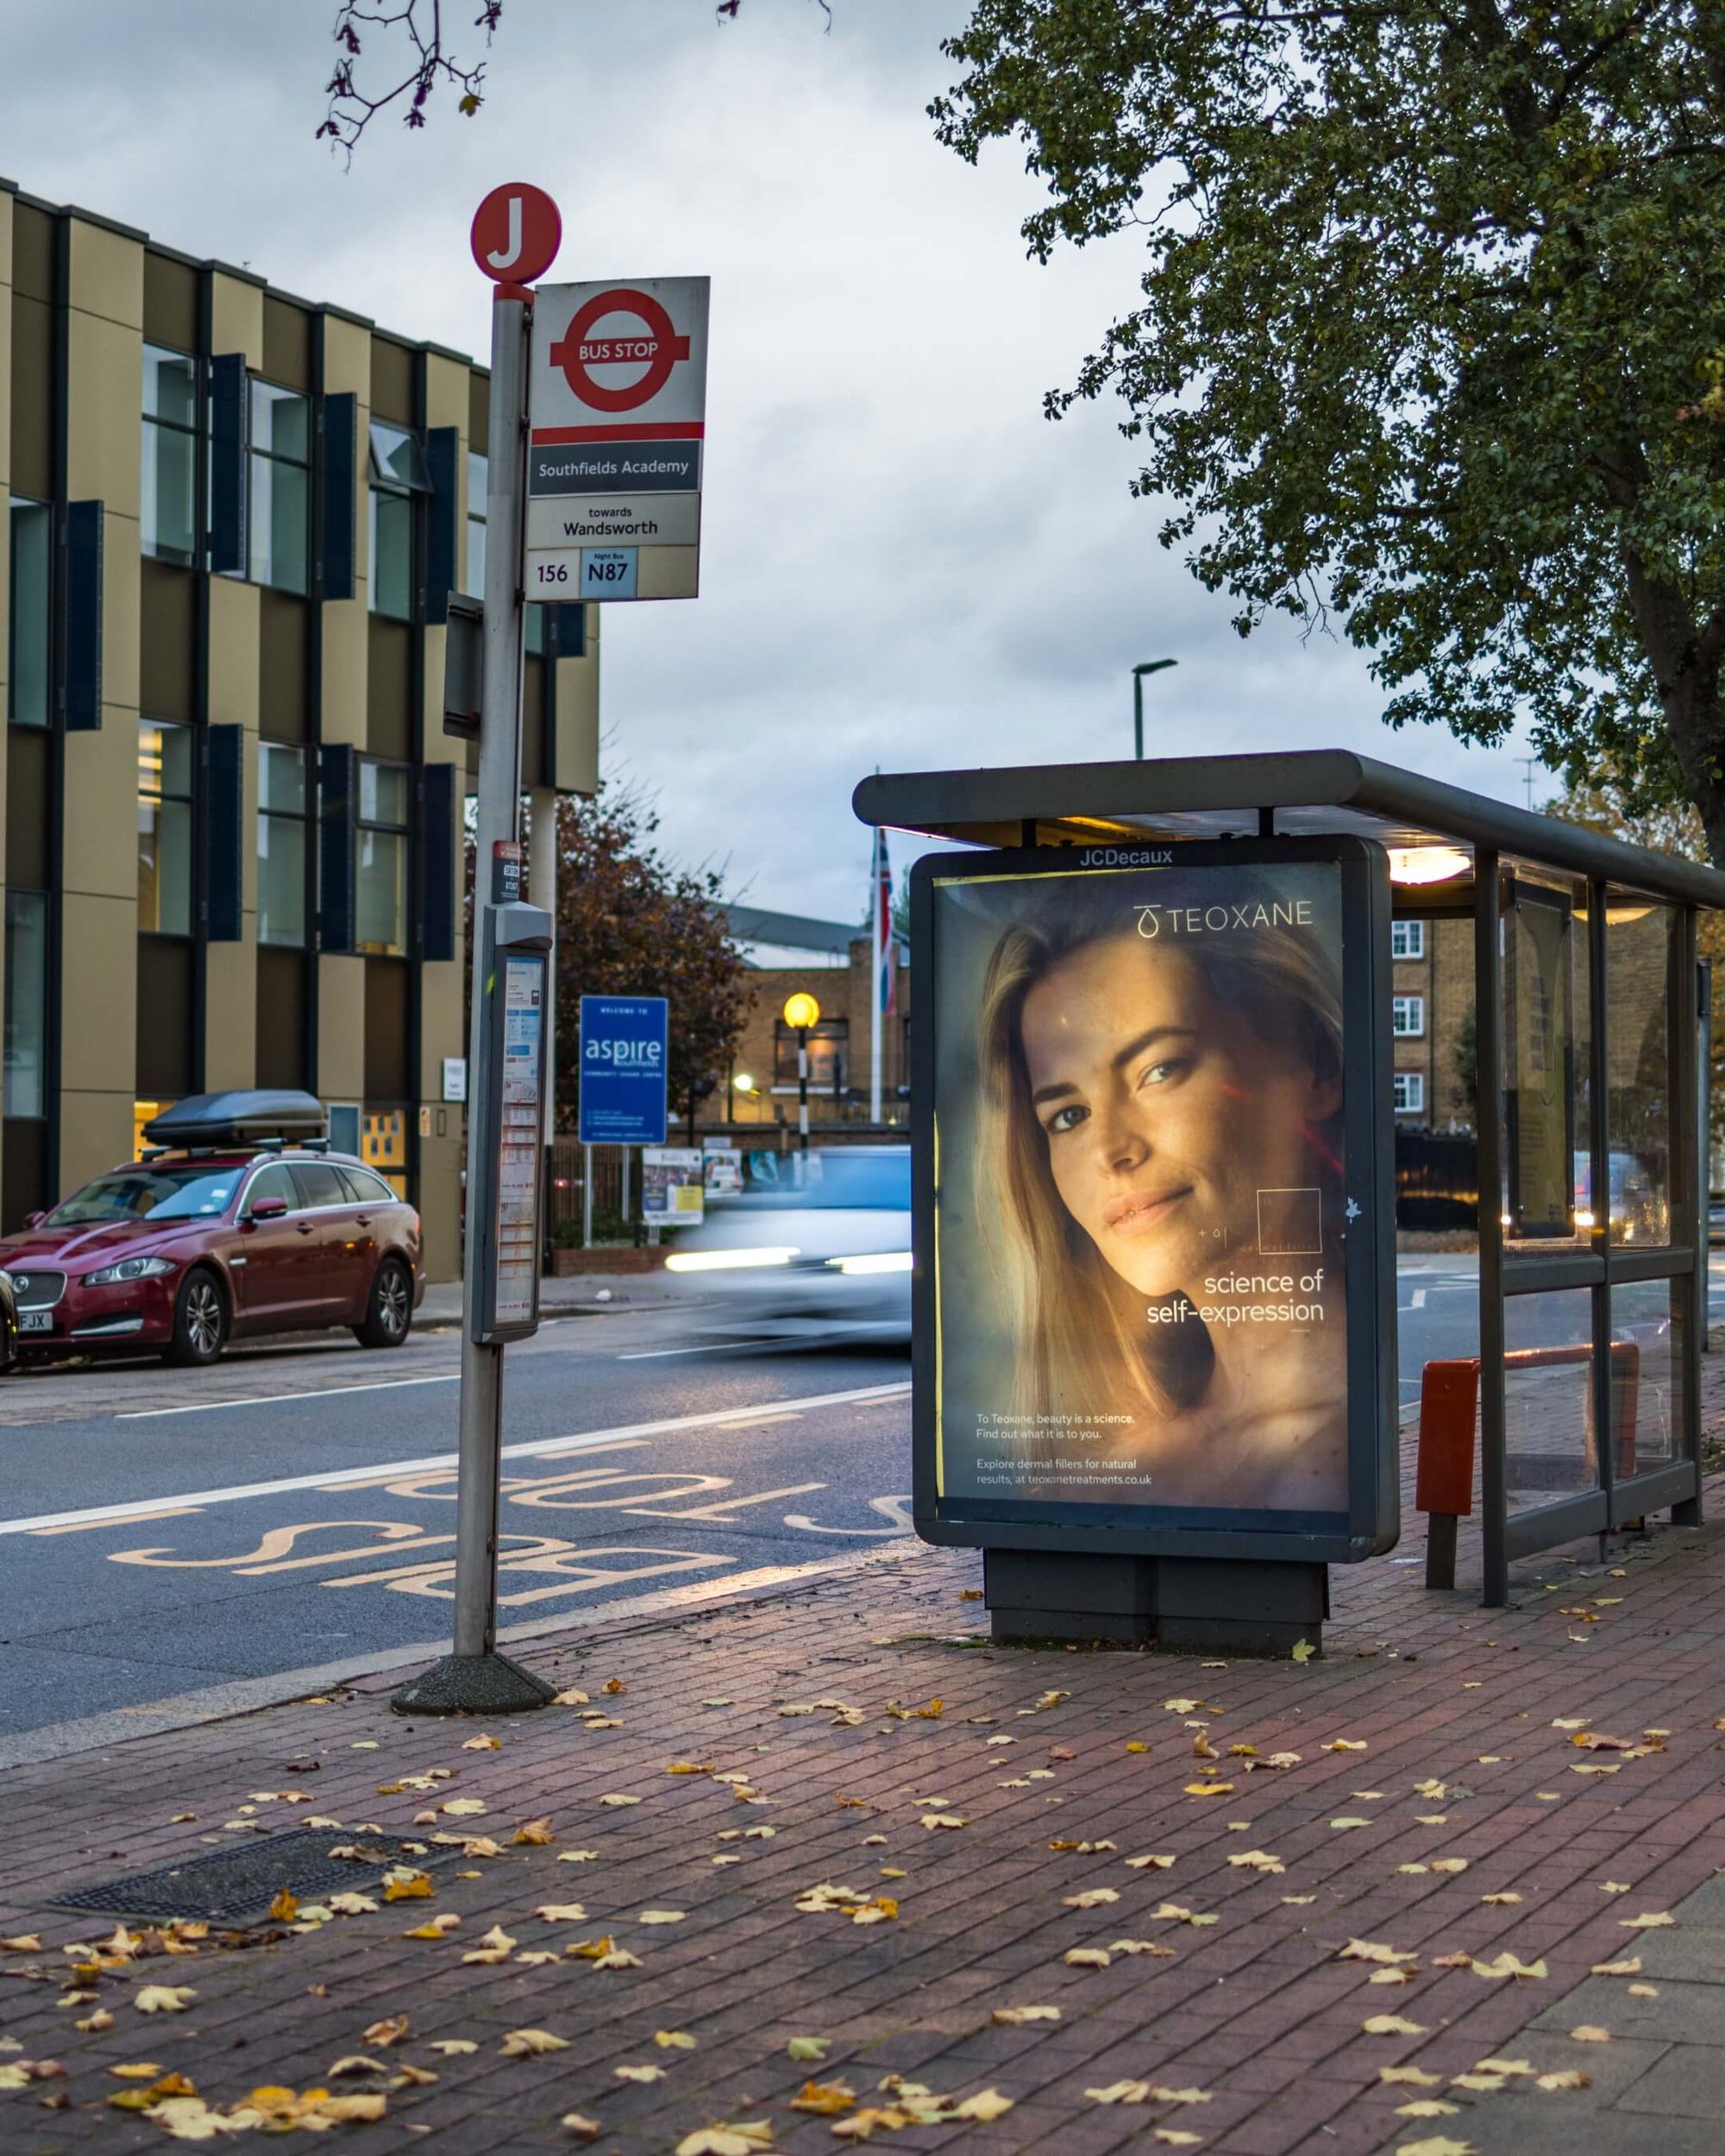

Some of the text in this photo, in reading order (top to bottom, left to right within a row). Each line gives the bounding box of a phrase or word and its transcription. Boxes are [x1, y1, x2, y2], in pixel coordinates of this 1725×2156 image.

[486, 197, 523, 269] J
[579, 342, 659, 360] BUS STOP
[539, 460, 689, 477] Southfields Academy
[588, 507, 633, 517] towards
[563, 521, 658, 536] Wandsworth
[593, 553, 612, 561] Night
[537, 565, 568, 582] 156
[588, 563, 628, 581] N87
[1080, 849, 1173, 867] JCDecaux
[1166, 900, 1314, 934] TEOXANE
[586, 1039, 662, 1066] aspire
[1204, 1269, 1325, 1294] science of
[1146, 1299, 1325, 1328] self-expression
[976, 1413, 988, 1424] To
[992, 1413, 1035, 1425] Teoxane,
[1037, 1414, 1072, 1426] beauty
[1075, 1414, 1082, 1424] is
[1094, 1414, 1135, 1424] science.
[976, 1429, 1101, 1441] Find out what it is to you.
[976, 1459, 1137, 1471] Explore dermal fillers for natural
[976, 1474, 1151, 1486] results, at teoxanetreatments.co.uk
[107, 1520, 738, 1607] BUS
